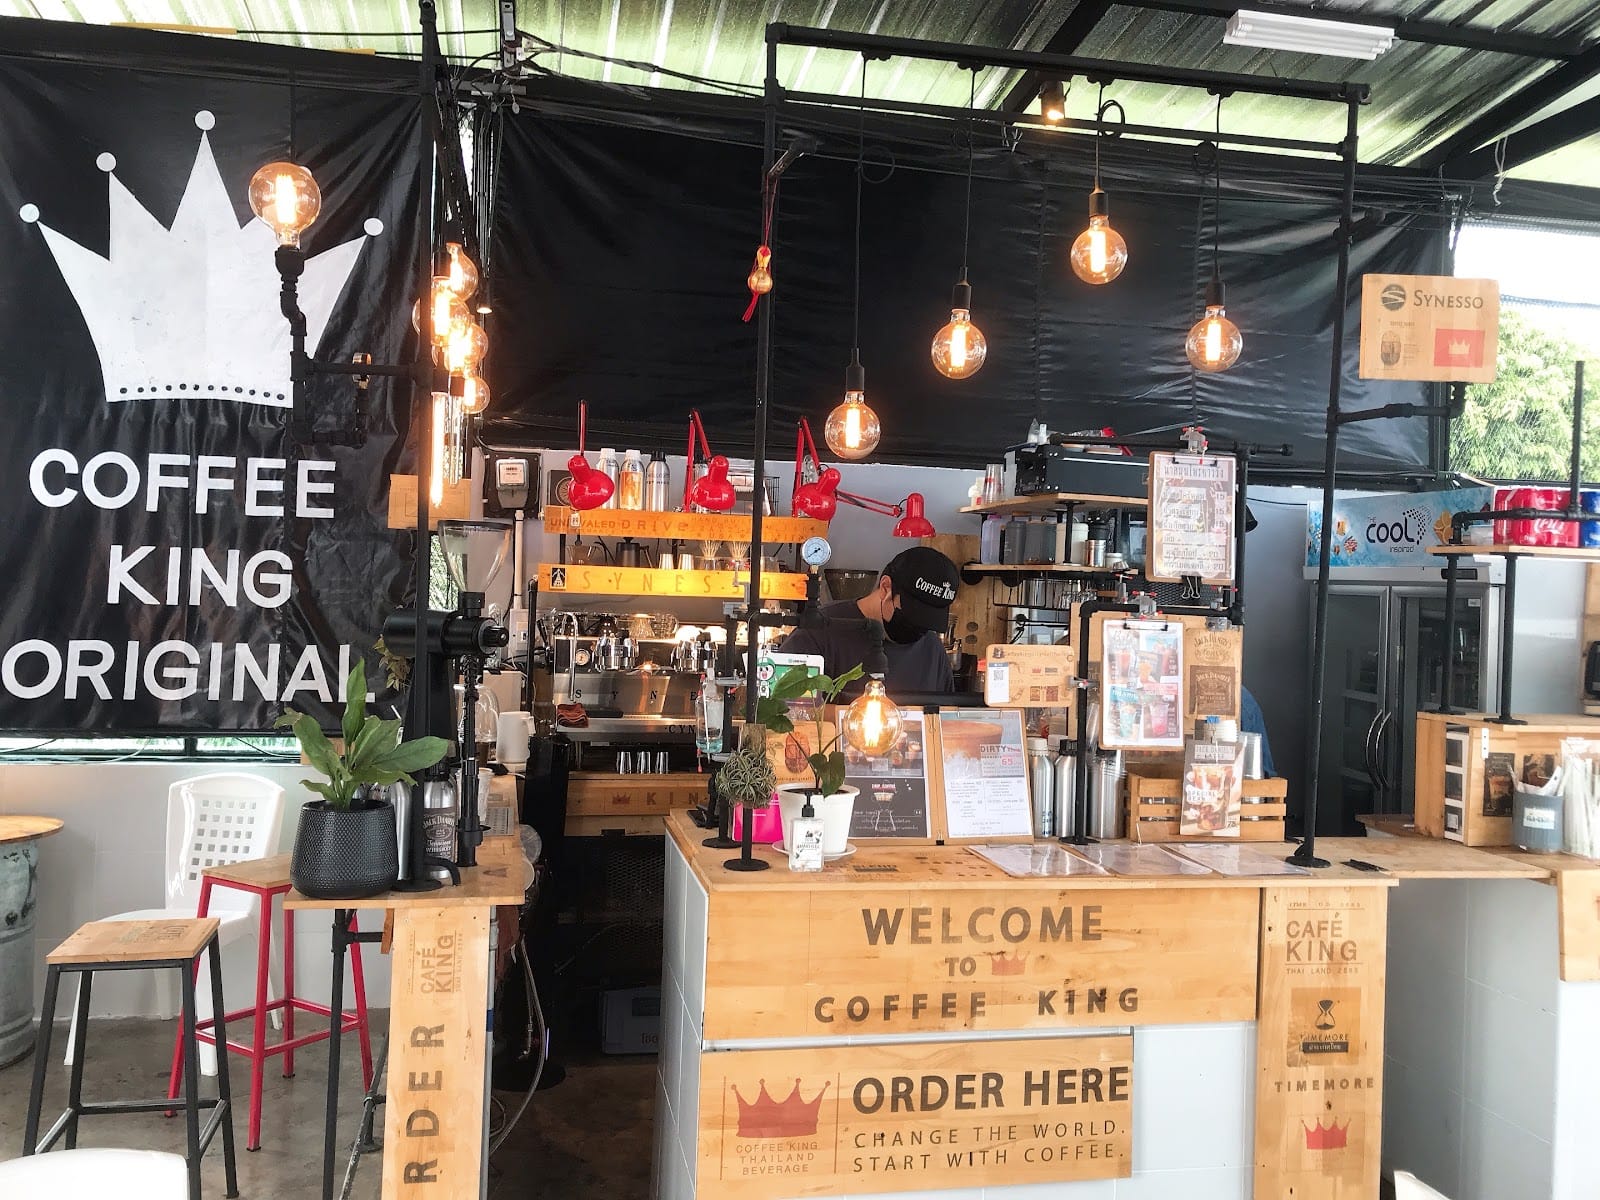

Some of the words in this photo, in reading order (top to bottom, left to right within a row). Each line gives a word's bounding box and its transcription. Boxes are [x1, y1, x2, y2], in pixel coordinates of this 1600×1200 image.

[1413, 289, 1484, 310] SYNESSO
[29, 448, 337, 519] COFFEE
[106, 545, 293, 609] KING
[915, 577, 943, 597] COFFEE
[1, 639, 376, 703] ORIGINAL
[980, 745, 1007, 753] DIRTY
[1001, 757, 1014, 766] 65
[646, 791, 699, 806] KIN
[862, 905, 1103, 946] WELCOME
[1286, 911, 1343, 939] CAFÉ
[1286, 939, 1358, 962] KING
[416, 947, 436, 994] CAFÉ
[435, 934, 454, 993] KING
[945, 957, 977, 977] TO
[814, 991, 986, 1023] COFFEE
[1038, 987, 1139, 1017] KING
[853, 1072, 1004, 1115] ORDER
[1023, 1066, 1129, 1107] HERE
[1274, 1078, 1374, 1093] TIMEMORE
[854, 1128, 959, 1149] CHANGE
[973, 1125, 1018, 1142] THE
[1033, 1120, 1126, 1139] WORLD.
[736, 1143, 784, 1154] COFFEE
[789, 1141, 818, 1151] KING
[740, 1152, 815, 1164] THAILAND
[853, 1154, 931, 1173] START
[946, 1149, 1008, 1168] WITH
[1023, 1143, 1125, 1162] COFFEE.
[742, 1164, 809, 1176] BEVERAGE
